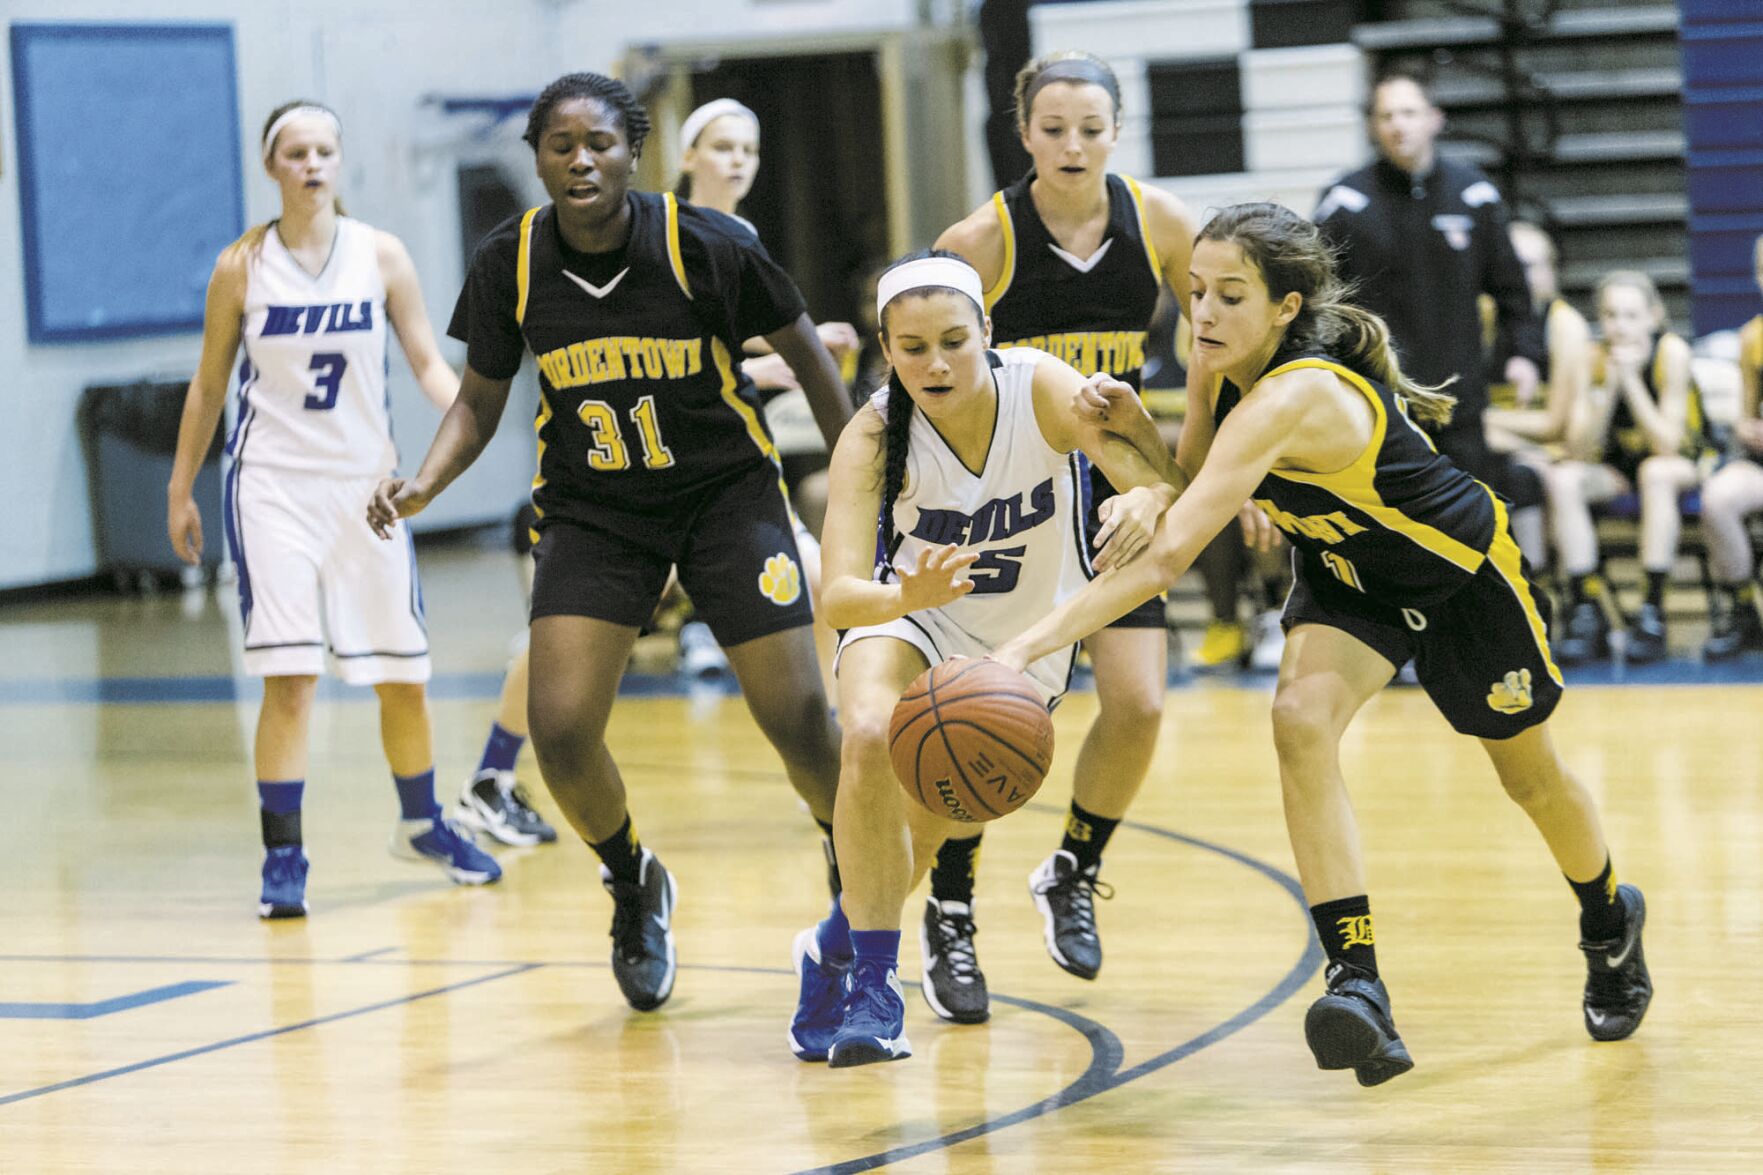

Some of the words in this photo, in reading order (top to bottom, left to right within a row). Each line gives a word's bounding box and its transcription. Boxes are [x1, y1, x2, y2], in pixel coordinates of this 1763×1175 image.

[259, 301, 373, 337] DEVILS
[303, 353, 348, 411] 3
[577, 395, 676, 471] 31
[909, 477, 1056, 547] DEVILS
[967, 544, 1027, 595] 5
[968, 751, 1026, 803] AVE
